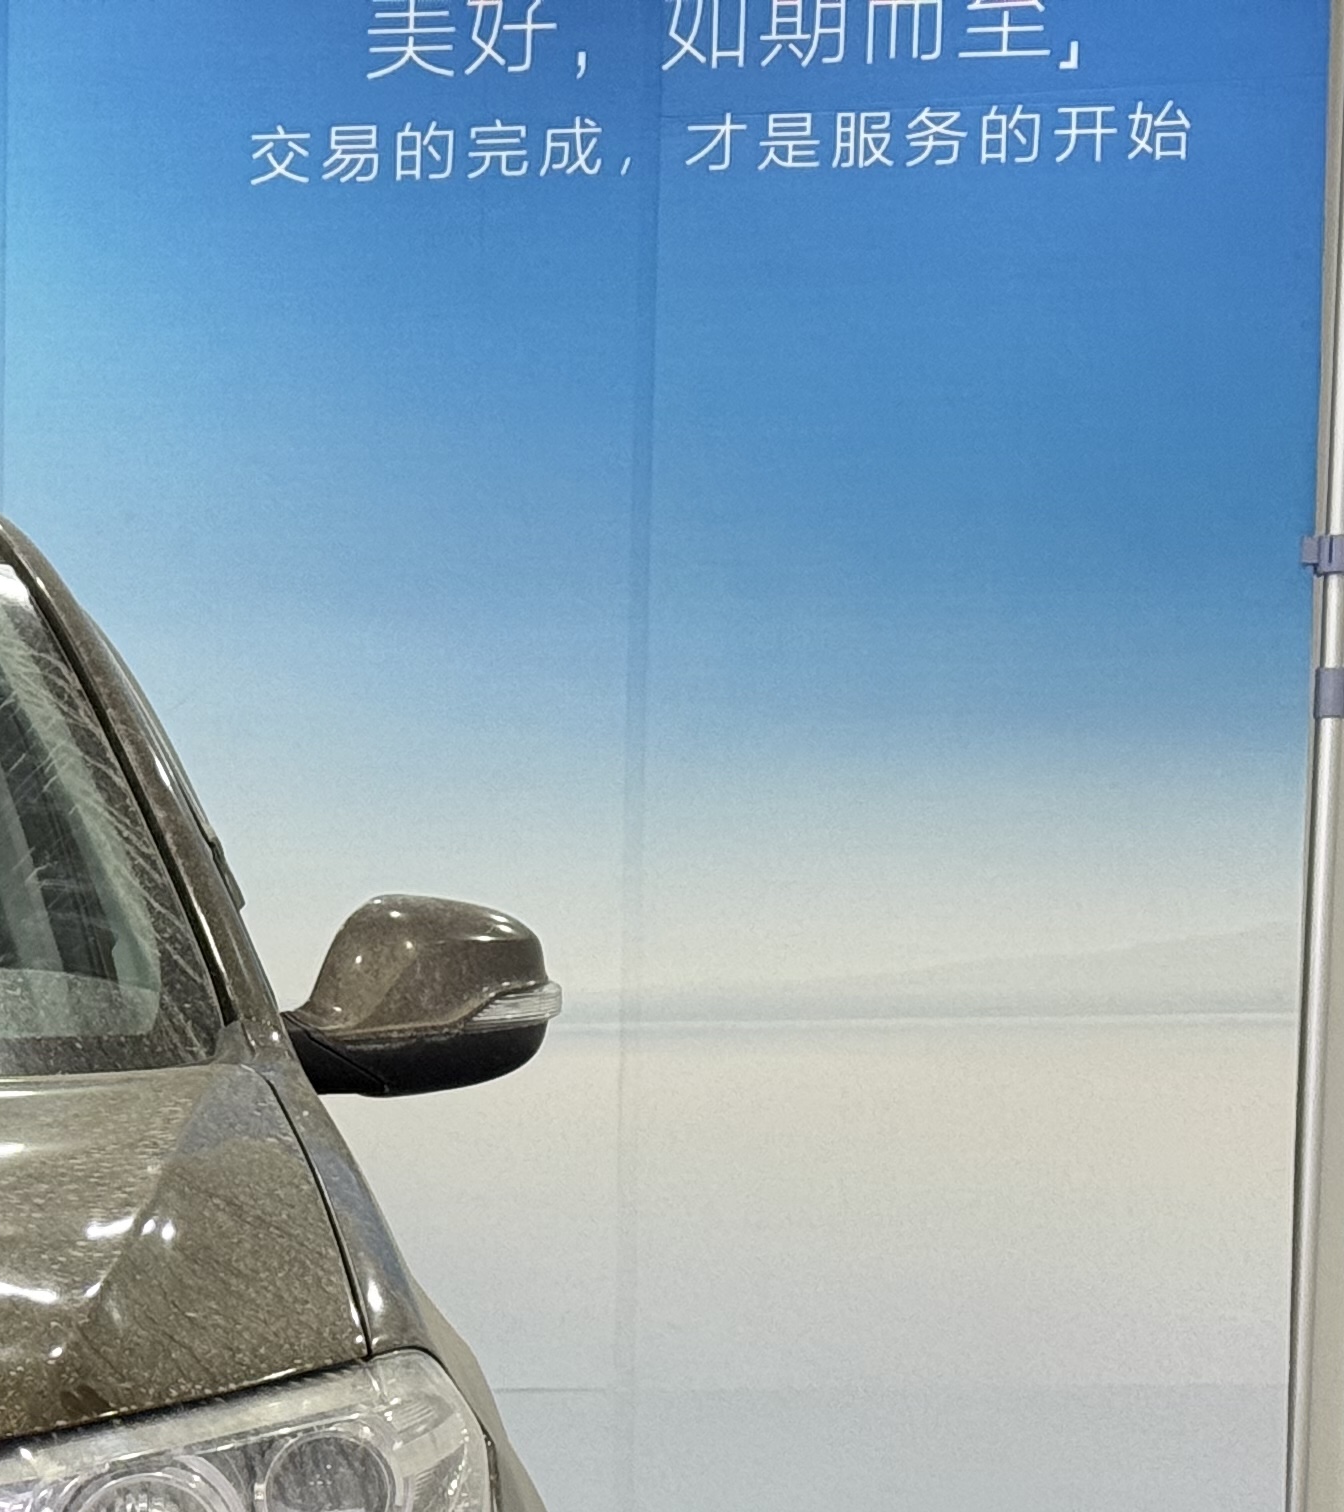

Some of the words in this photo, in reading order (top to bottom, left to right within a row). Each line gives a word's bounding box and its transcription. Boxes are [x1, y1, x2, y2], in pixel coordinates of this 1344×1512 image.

[249, 99, 1192, 186] 交易的完成，才是服务的开始
